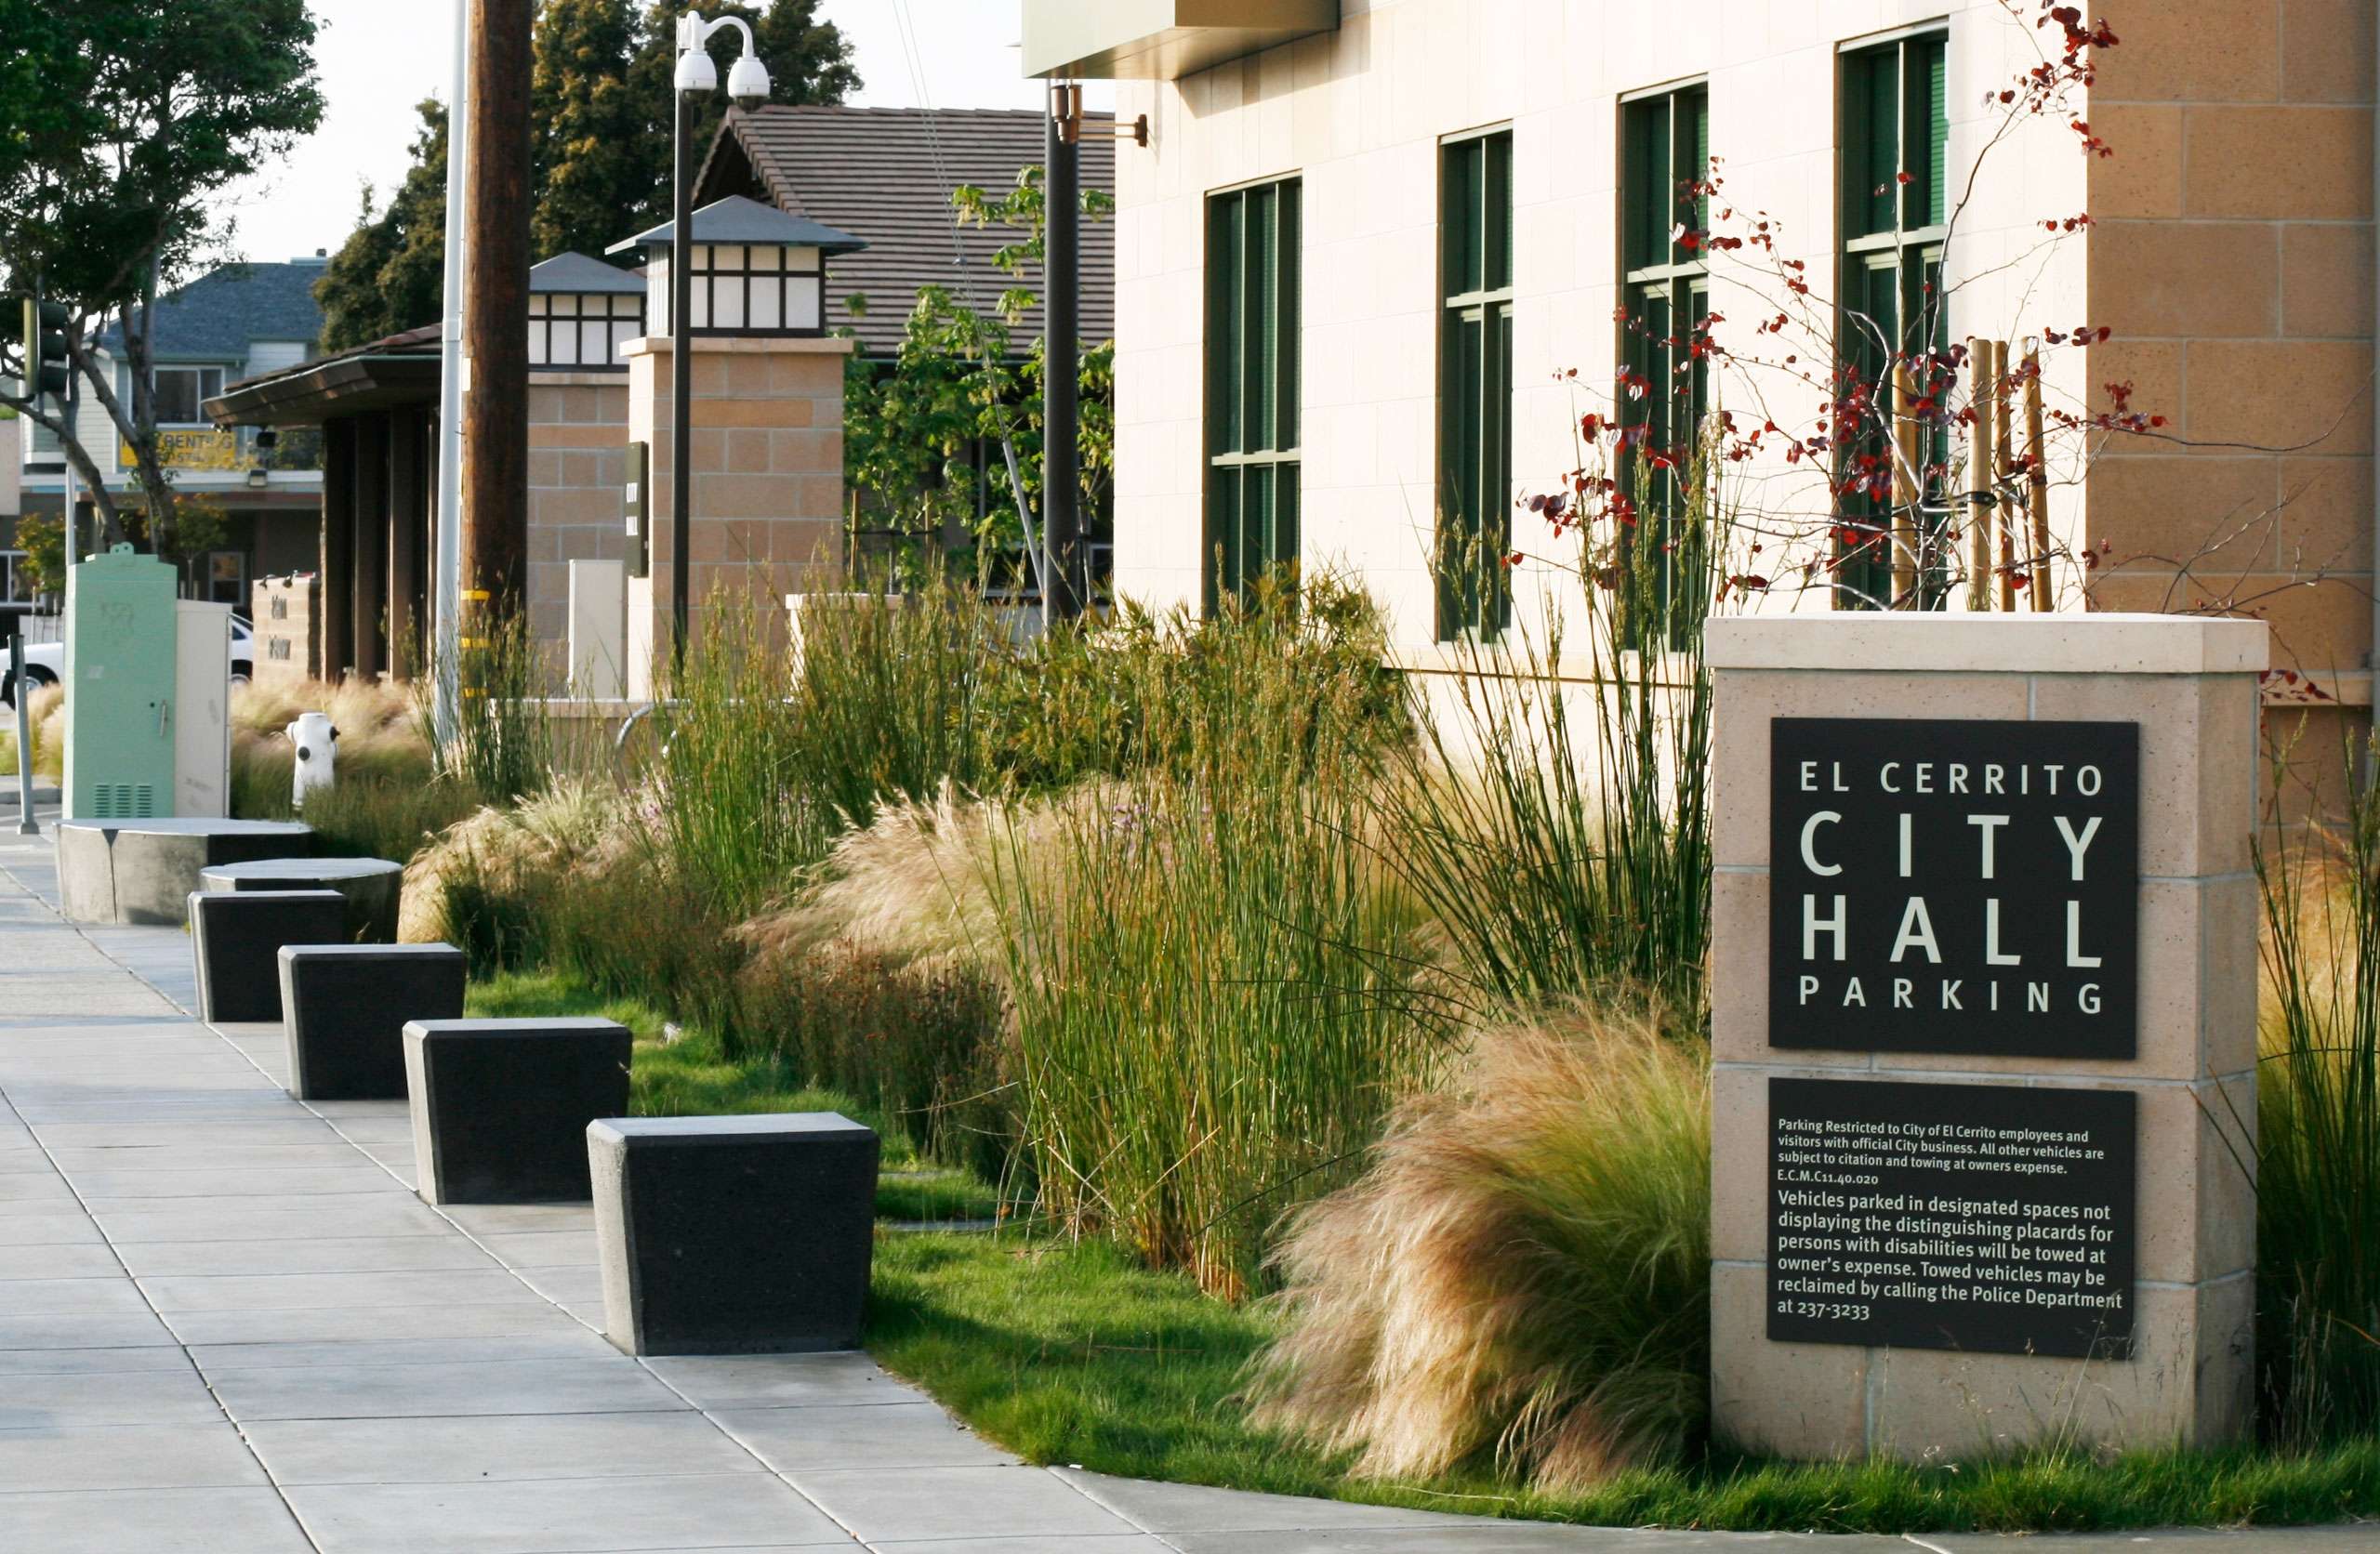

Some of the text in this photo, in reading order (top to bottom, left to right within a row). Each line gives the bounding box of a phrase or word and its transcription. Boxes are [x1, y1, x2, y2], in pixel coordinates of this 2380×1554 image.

[1801, 760, 2102, 797] EL CERRITO
[1800, 810, 2103, 881] CITY
[1803, 893, 2102, 968] HALL
[1799, 975, 2101, 1015] PARKING
[1778, 1118, 2088, 1143] Parking Restricted to City of El Cerrito employees and
[1778, 1134, 2104, 1159] visitors with official City business. All other vehicles are
[1778, 1151, 2068, 1175] subject to citation and towing at owners expense.
[1778, 1190, 2110, 1220] Vehicles parked in designated spaces not
[1778, 1211, 2113, 1242] displaying the distinguishing placards for
[1778, 1236, 2106, 1264] persons with disabilities will be towed at
[1778, 1257, 2105, 1288] owner's expense. Towed vehicles may be
[1778, 1277, 2122, 1309] reclaimed by calling the Police Department
[1778, 1298, 1870, 1321] at 237-3233
